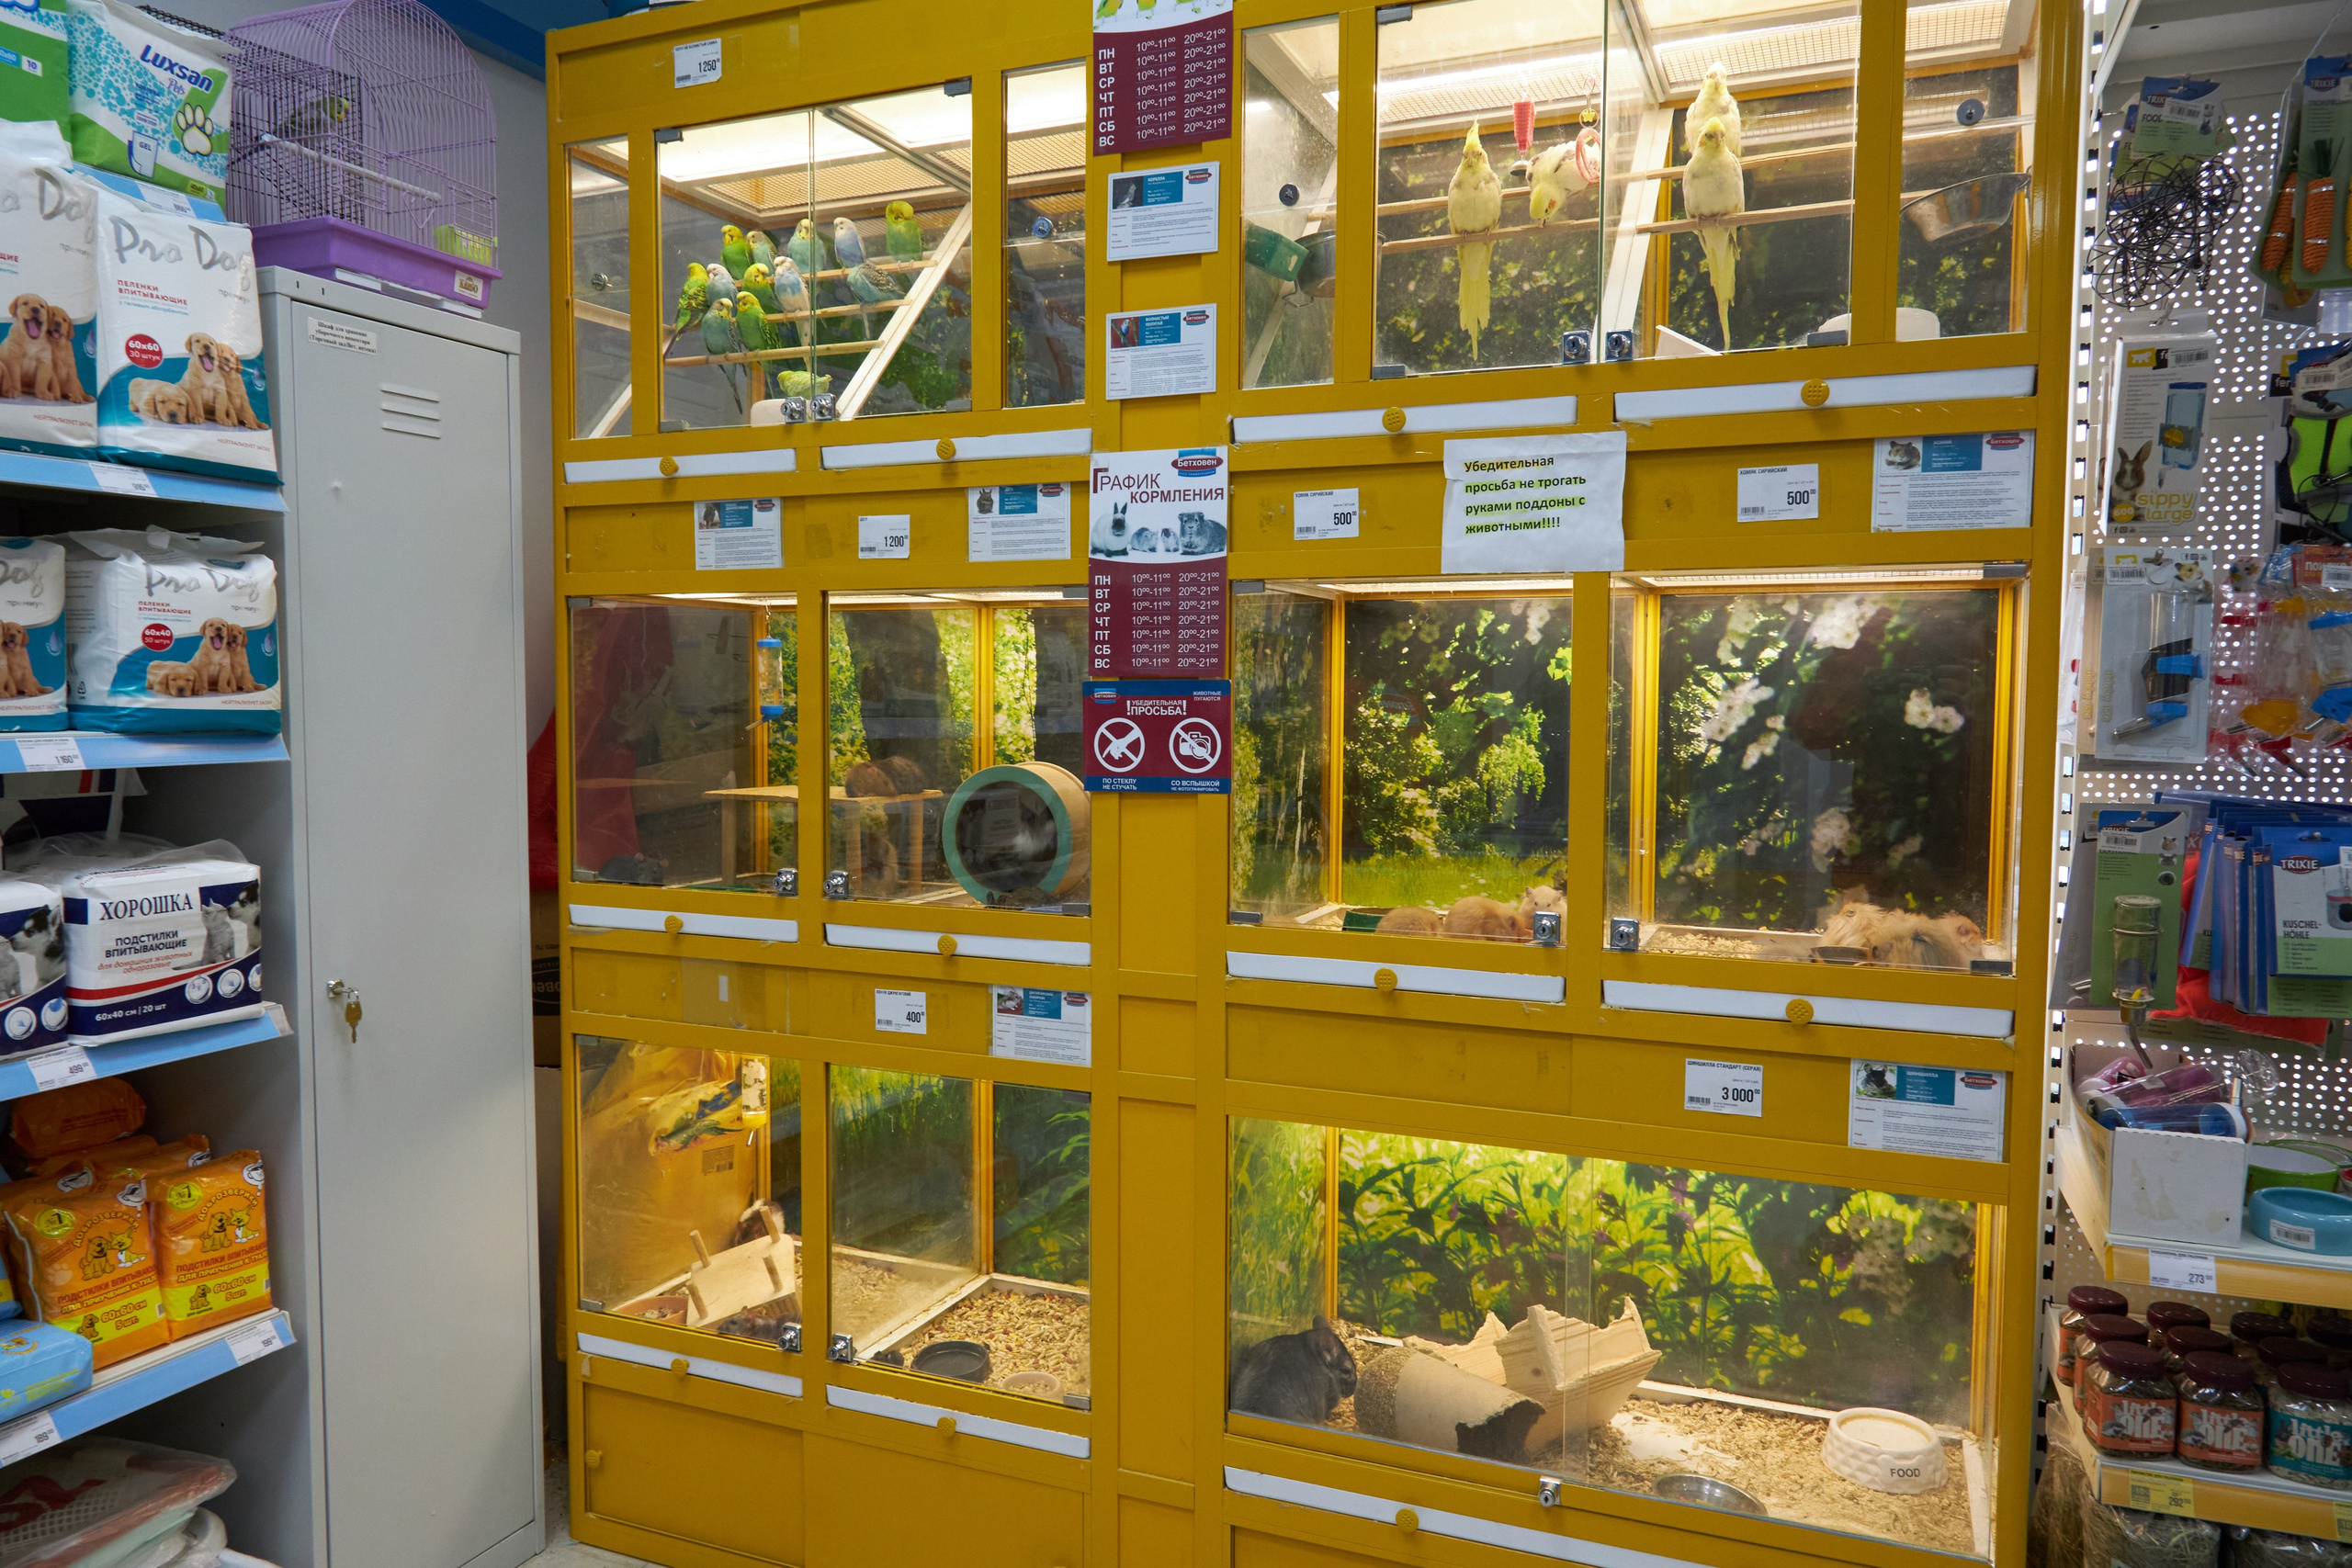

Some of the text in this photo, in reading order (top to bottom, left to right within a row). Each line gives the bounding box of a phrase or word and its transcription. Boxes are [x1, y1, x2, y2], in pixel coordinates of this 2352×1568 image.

[1099, 48, 1114, 60] ПН
[27, 60, 38, 70] 10
[140, 44, 213, 92] Luxsan
[1099, 62, 1114, 74] ВТ
[167, 77, 186, 96] Pets
[1099, 77, 1114, 89] СР
[1099, 91, 1114, 103] ЧТ
[2147, 96, 2165, 104] TRIX
[1099, 106, 1114, 118] ПТ
[1099, 120, 1115, 132] СБ
[140, 141, 152, 152] GEL
[1099, 135, 1114, 147] ВС
[108, 214, 183, 265] Pro
[117, 279, 159, 292] ПЕЛЕНКИ
[119, 287, 187, 306] ВПИТЫВАЮЩИЕ
[129, 350, 161, 362] 30 штук
[1177, 458, 1217, 468] Бетховен
[1464, 457, 1555, 473] Убедительная
[1092, 467, 1161, 494] ГРАФИК
[1464, 476, 1587, 494] просьба не трогать
[1130, 487, 1224, 504] КОРМЛЕНИЯ
[1787, 491, 1810, 505] 500
[2137, 491, 2194, 509] sippy
[1465, 496, 1586, 516] руками поддоны с
[2114, 507, 2133, 516] 600
[1333, 512, 1351, 525] 500
[2146, 507, 2193, 524] large
[1464, 517, 1561, 535] животными!!!!
[142, 562, 201, 597] Pro
[1094, 575, 1111, 585] ПН
[1095, 589, 1110, 599] ВТ
[138, 606, 191, 615] ВПИТЫВАЮЩИЕ
[1094, 603, 1111, 613] СР
[1095, 616, 1110, 627] ЧТ
[1095, 630, 1110, 641] ПТ
[1094, 644, 1111, 655] СБ
[1094, 658, 1110, 669] ВС
[1182, 779, 1220, 787] ВСПЫШКОЙ
[2279, 859, 2320, 870] TRIXIE
[99, 893, 193, 921] ХОРОШКА
[2283, 920, 2322, 929] KUSCHEL-
[115, 930, 179, 946] ПОДСТИЛКИ
[2283, 930, 2310, 939] HÖHLE
[105, 939, 187, 958] ВПИТЫВАЮЩИЕ
[97, 951, 193, 971] для домашних животных
[122, 961, 171, 974] одноразовые
[125, 1009, 137, 1017] см
[142, 1005, 153, 1013] 20
[154, 1003, 167, 1011] шт
[906, 1011, 921, 1023] 400
[1906, 1070, 1939, 1078] ШИНШИЛЛА
[198, 1188, 258, 1222] ДОБРОЗВЕРИКИ
[73, 1211, 140, 1247] ДОБРОЗВЕРИКИ
[175, 1244, 267, 1273] ПОДСТИЛКИ ВПИТЫВАЮ
[177, 1258, 250, 1283] ДЛЯ ПРИУЧЕНИЯ К
[245, 1275, 256, 1284] см
[2188, 1273, 2205, 1284] 273
[58, 1280, 109, 1304] ПОДСТИЛКИ
[62, 1282, 138, 1314] ДЛЯ ПРИУЧЕНИЯ К
[225, 1289, 247, 1302] 5 шт.
[135, 1300, 147, 1311] см
[116, 1316, 139, 1330] 5 шт.
[1890, 1468, 1920, 1478] FOOD
